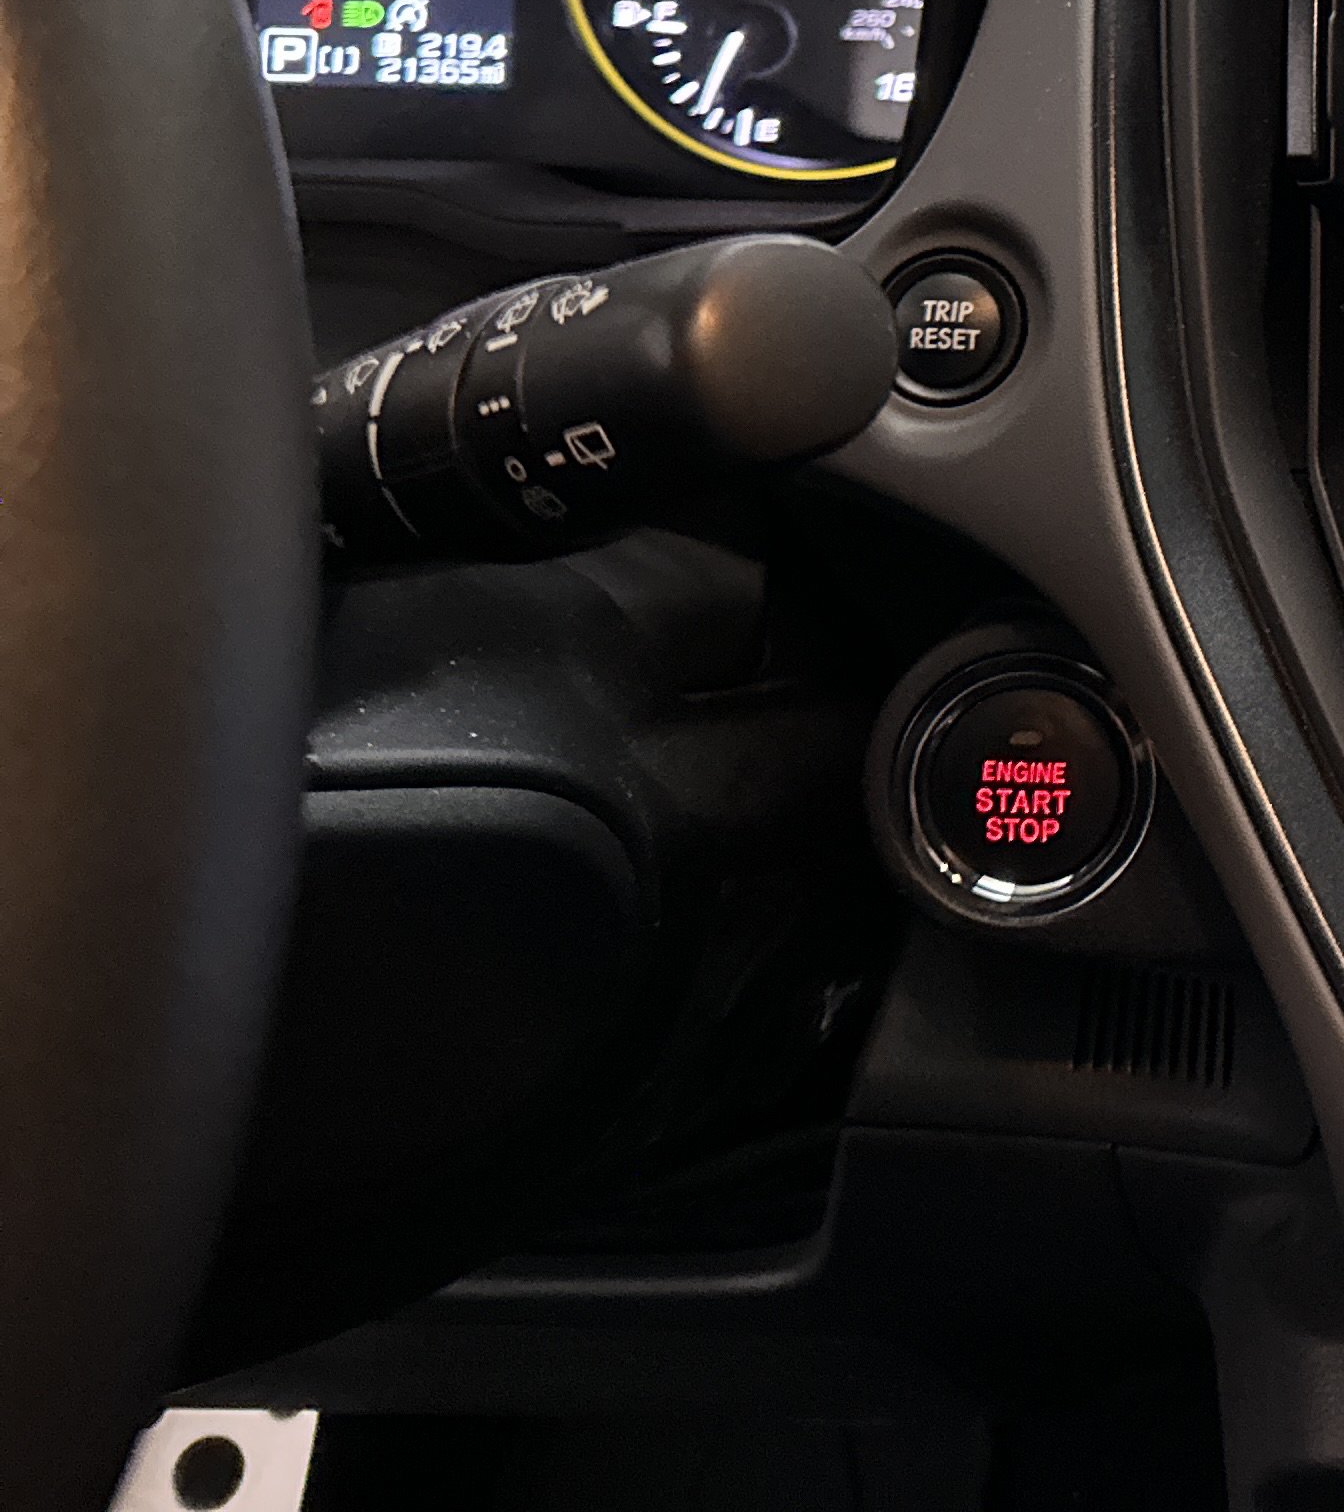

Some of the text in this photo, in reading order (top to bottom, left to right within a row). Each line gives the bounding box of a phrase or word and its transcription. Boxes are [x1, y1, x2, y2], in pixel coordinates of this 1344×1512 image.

[923, 299, 975, 323] TRIP
[909, 326, 981, 350] RESET
[982, 760, 1067, 784] ENGINE
[975, 787, 1071, 815] START
[986, 816, 1060, 843] STOP
